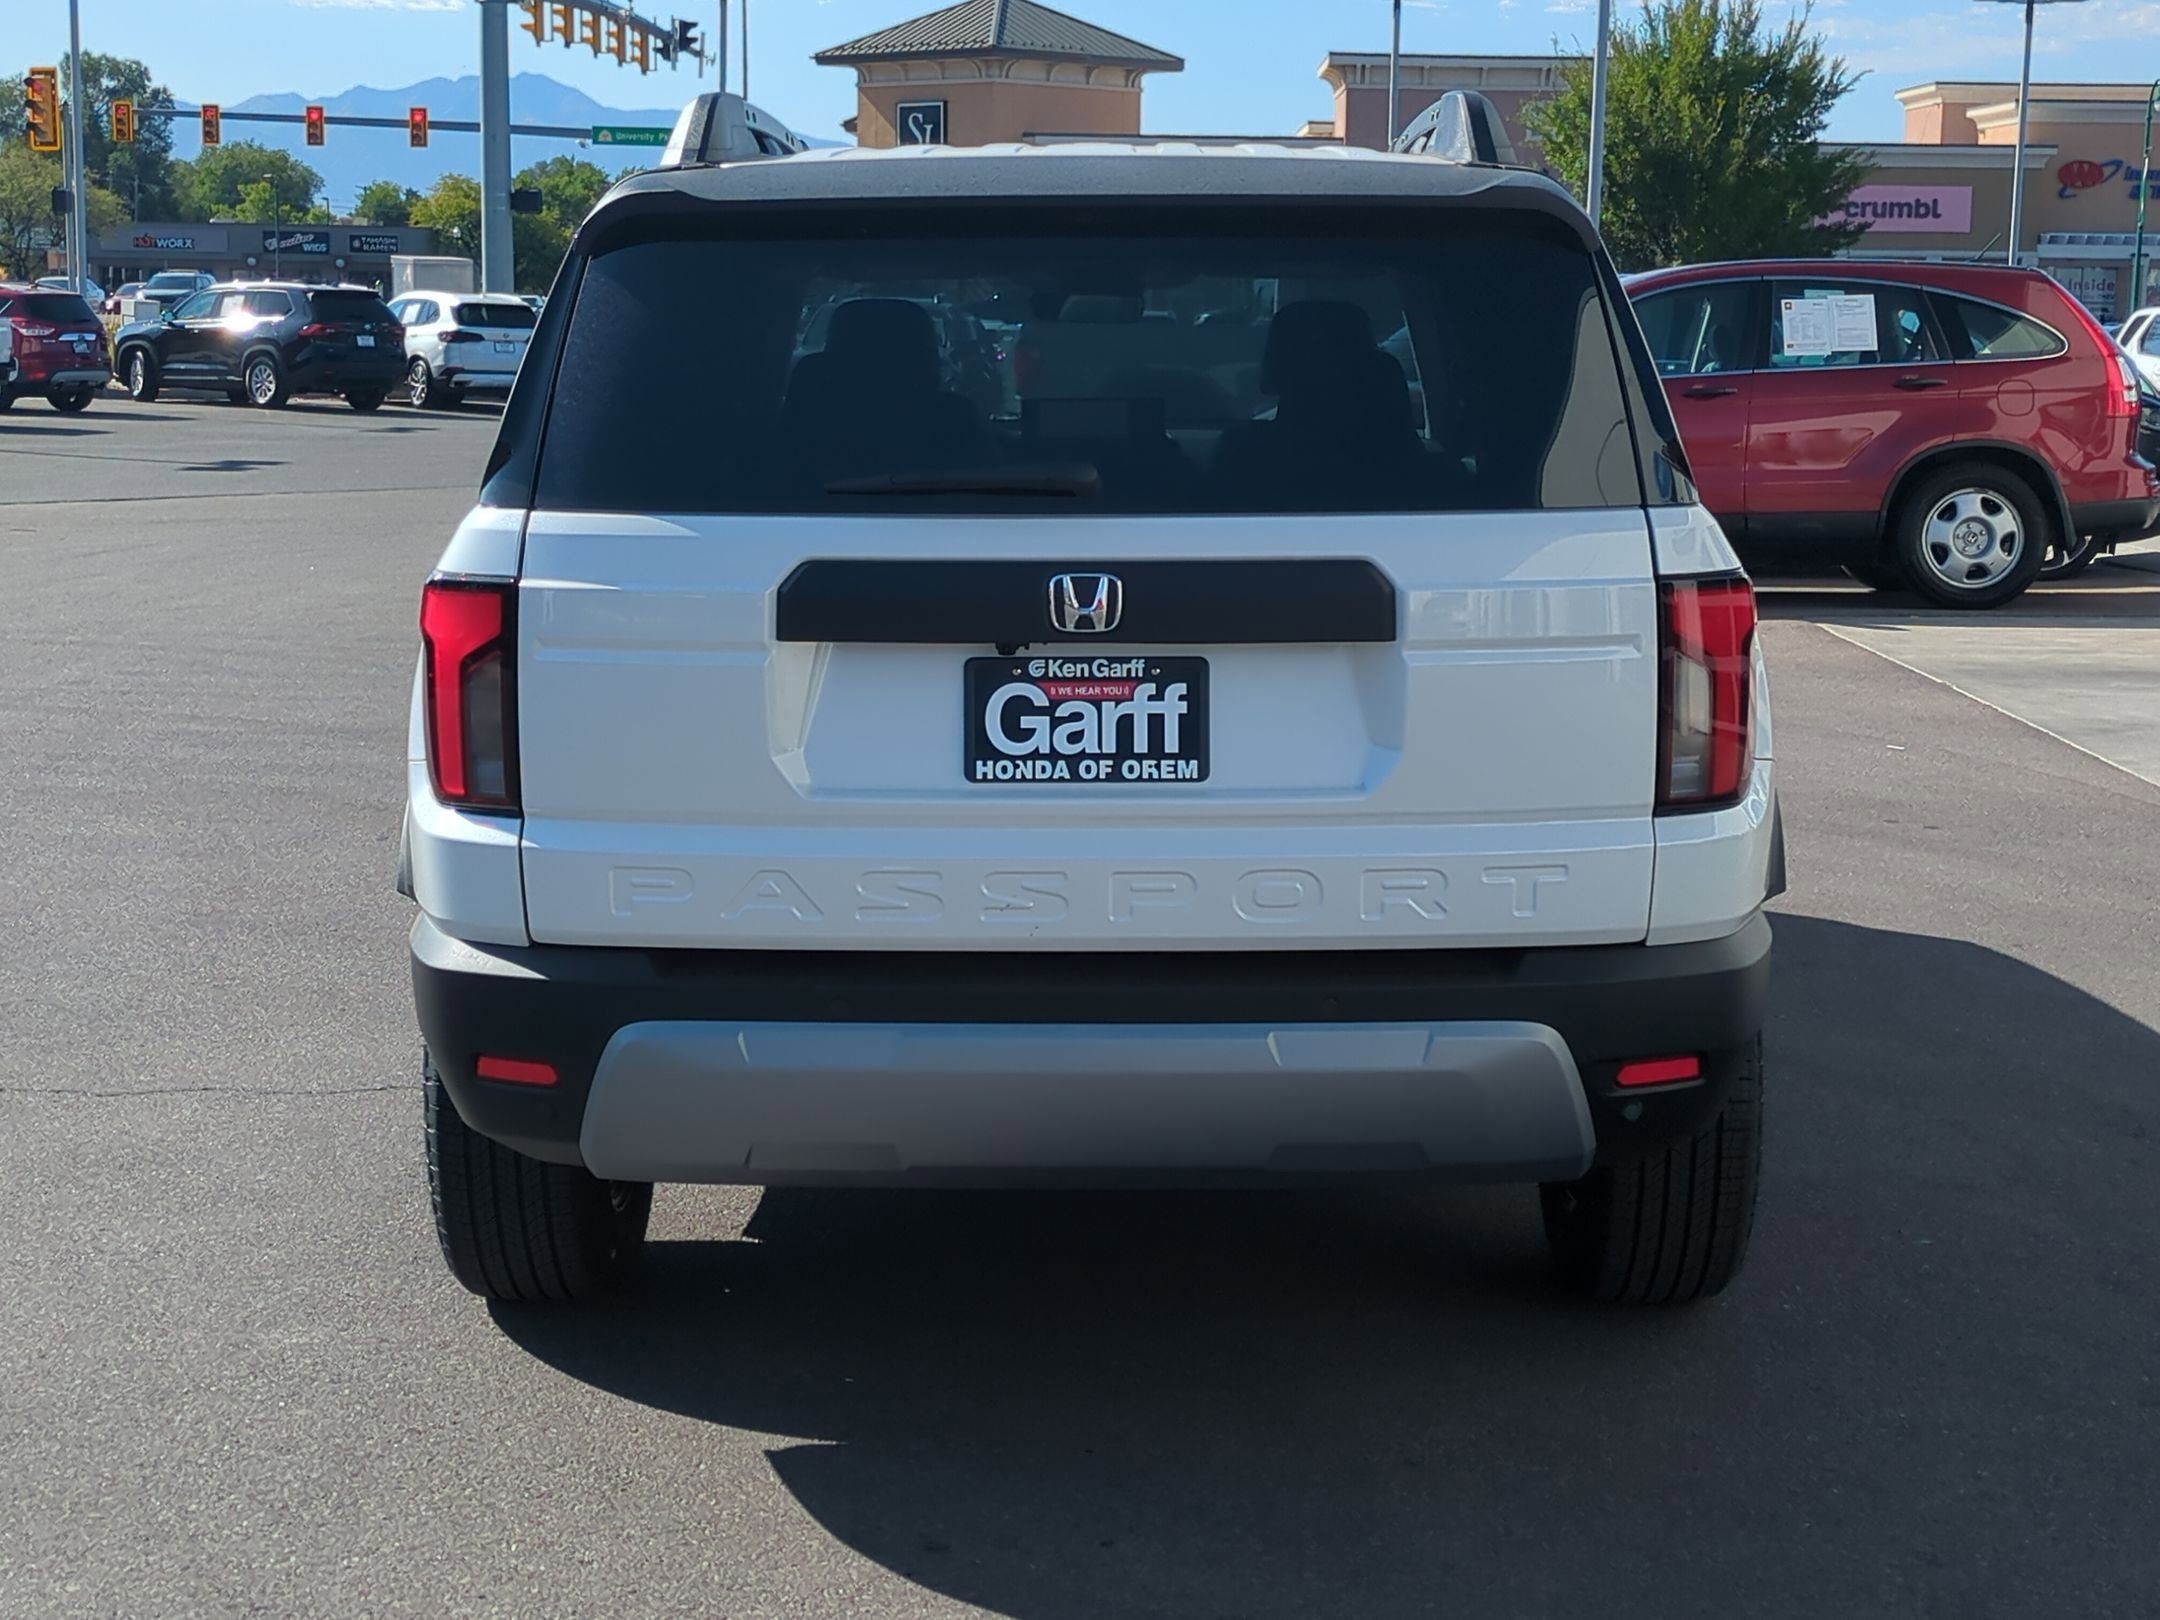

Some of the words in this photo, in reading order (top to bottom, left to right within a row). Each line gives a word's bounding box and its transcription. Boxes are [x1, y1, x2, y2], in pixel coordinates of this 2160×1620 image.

[1845, 198, 1942, 219] crumbl
[134, 234, 193, 249] HOTWORX
[302, 243, 327, 252] WIGS
[363, 244, 397, 252] RAMEN
[2068, 279, 2115, 291] Inside
[1048, 659, 1090, 677] Ken
[1092, 659, 1145, 677] Garff
[1057, 687, 1073, 695] WE
[1075, 687, 1101, 695] HEAR
[1103, 687, 1122, 695] YOU
[984, 682, 1188, 756] Garff
[975, 760, 1071, 779] HONDA
[1078, 760, 1114, 779] OF
[1121, 760, 1199, 779] OREM
[609, 865, 1569, 923] PASSPORT
